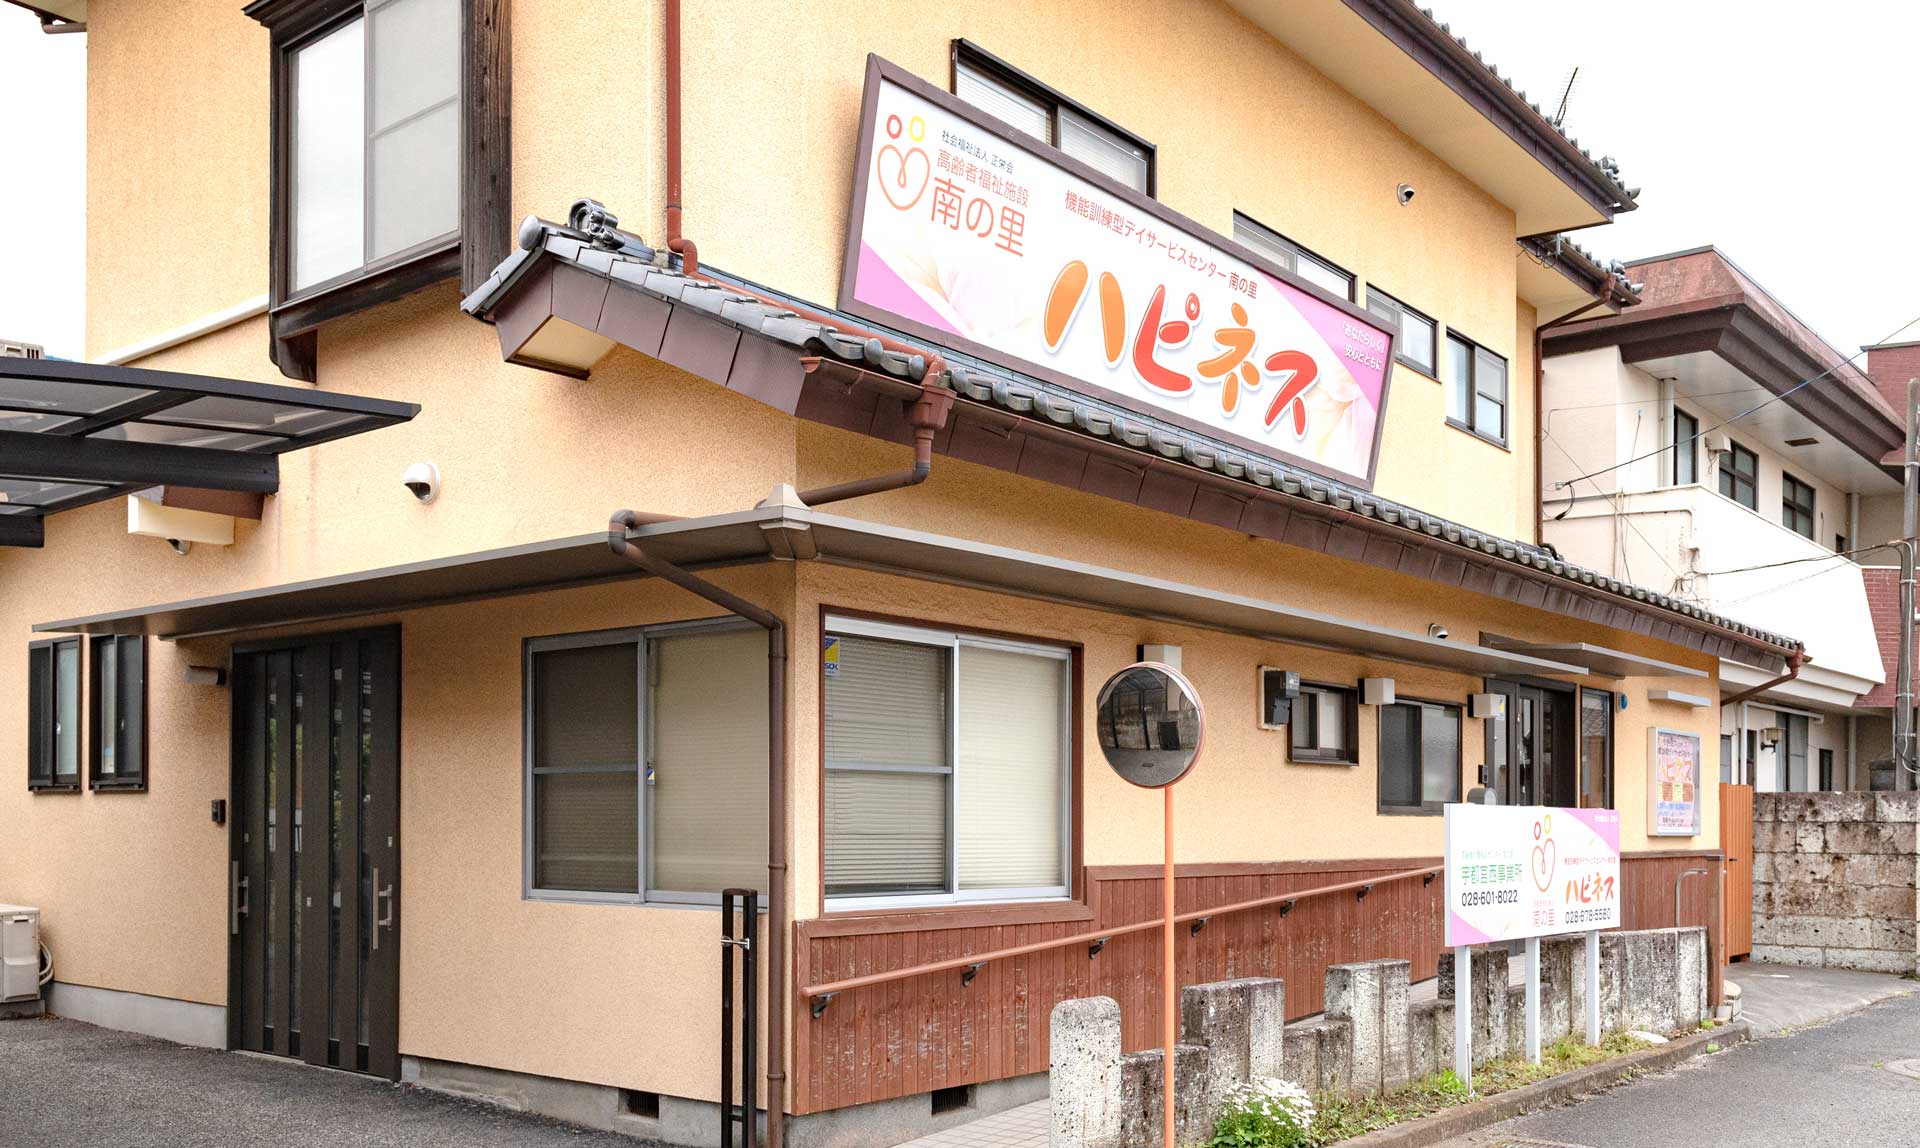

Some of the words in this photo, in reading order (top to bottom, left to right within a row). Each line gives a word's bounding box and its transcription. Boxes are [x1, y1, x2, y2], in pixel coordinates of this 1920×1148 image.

[936, 148, 1030, 208] 高齢者福祉施設
[942, 130, 989, 163] 社会福祉法人
[991, 153, 1014, 175] 正栄会
[931, 176, 1024, 257] 南の里
[1064, 190, 1226, 278] 機能訓練型デイサービスセンター
[1228, 271, 1258, 300] 南の里
[1043, 259, 1318, 436] ハピネス
[1461, 863, 1523, 885] 宇都宮西事業所
[1565, 871, 1615, 905] ハピネス
